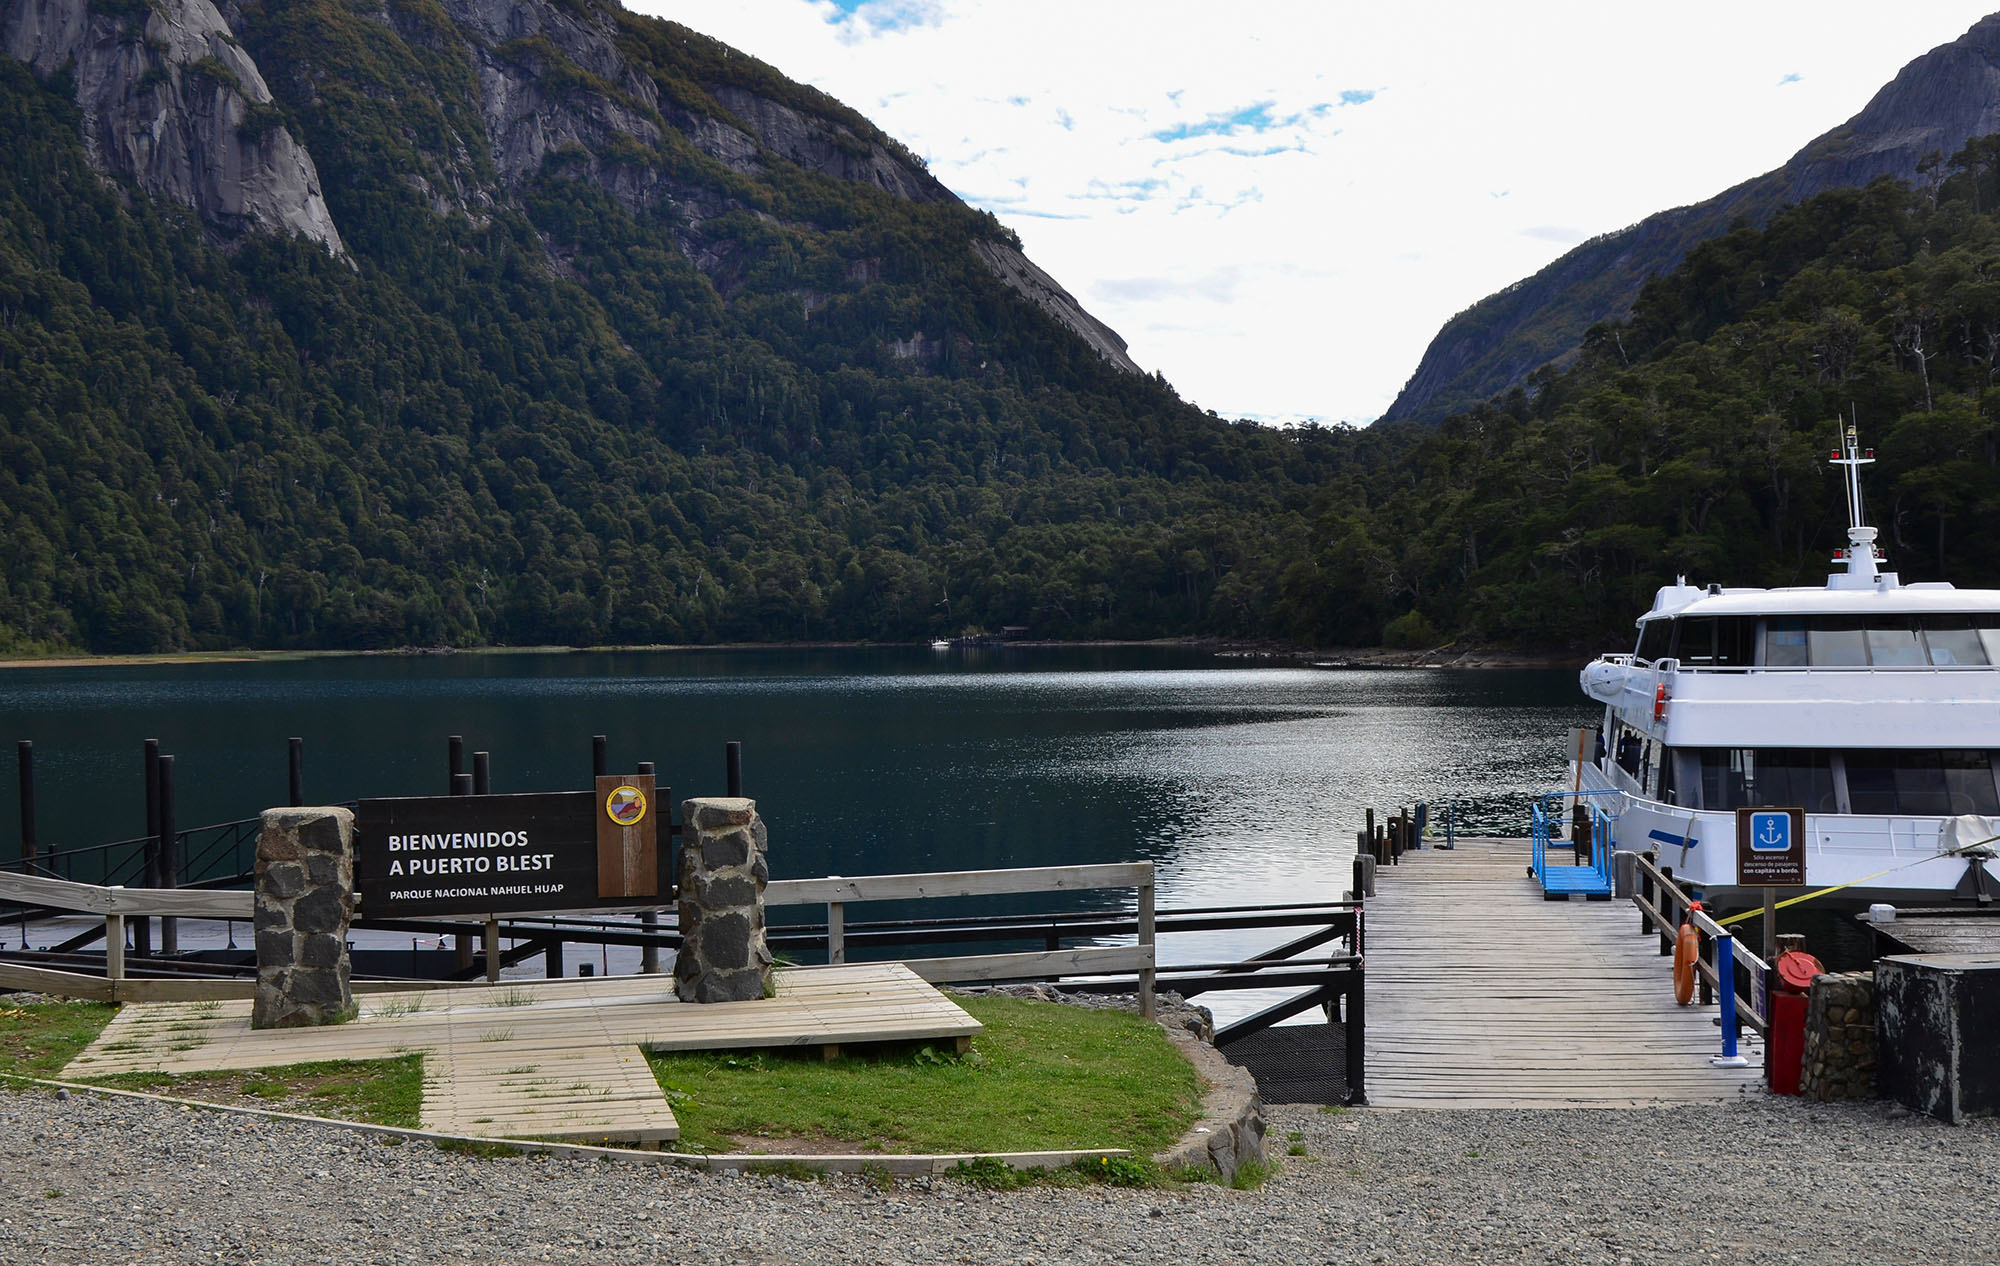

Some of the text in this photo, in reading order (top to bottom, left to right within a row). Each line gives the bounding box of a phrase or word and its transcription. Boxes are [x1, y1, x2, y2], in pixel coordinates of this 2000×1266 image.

[389, 831, 528, 851] BIENVENIDOS
[390, 854, 554, 875] A PUERTO BLEST
[390, 884, 563, 899] PARQUE NACIONAL NAHUEL HUAP
